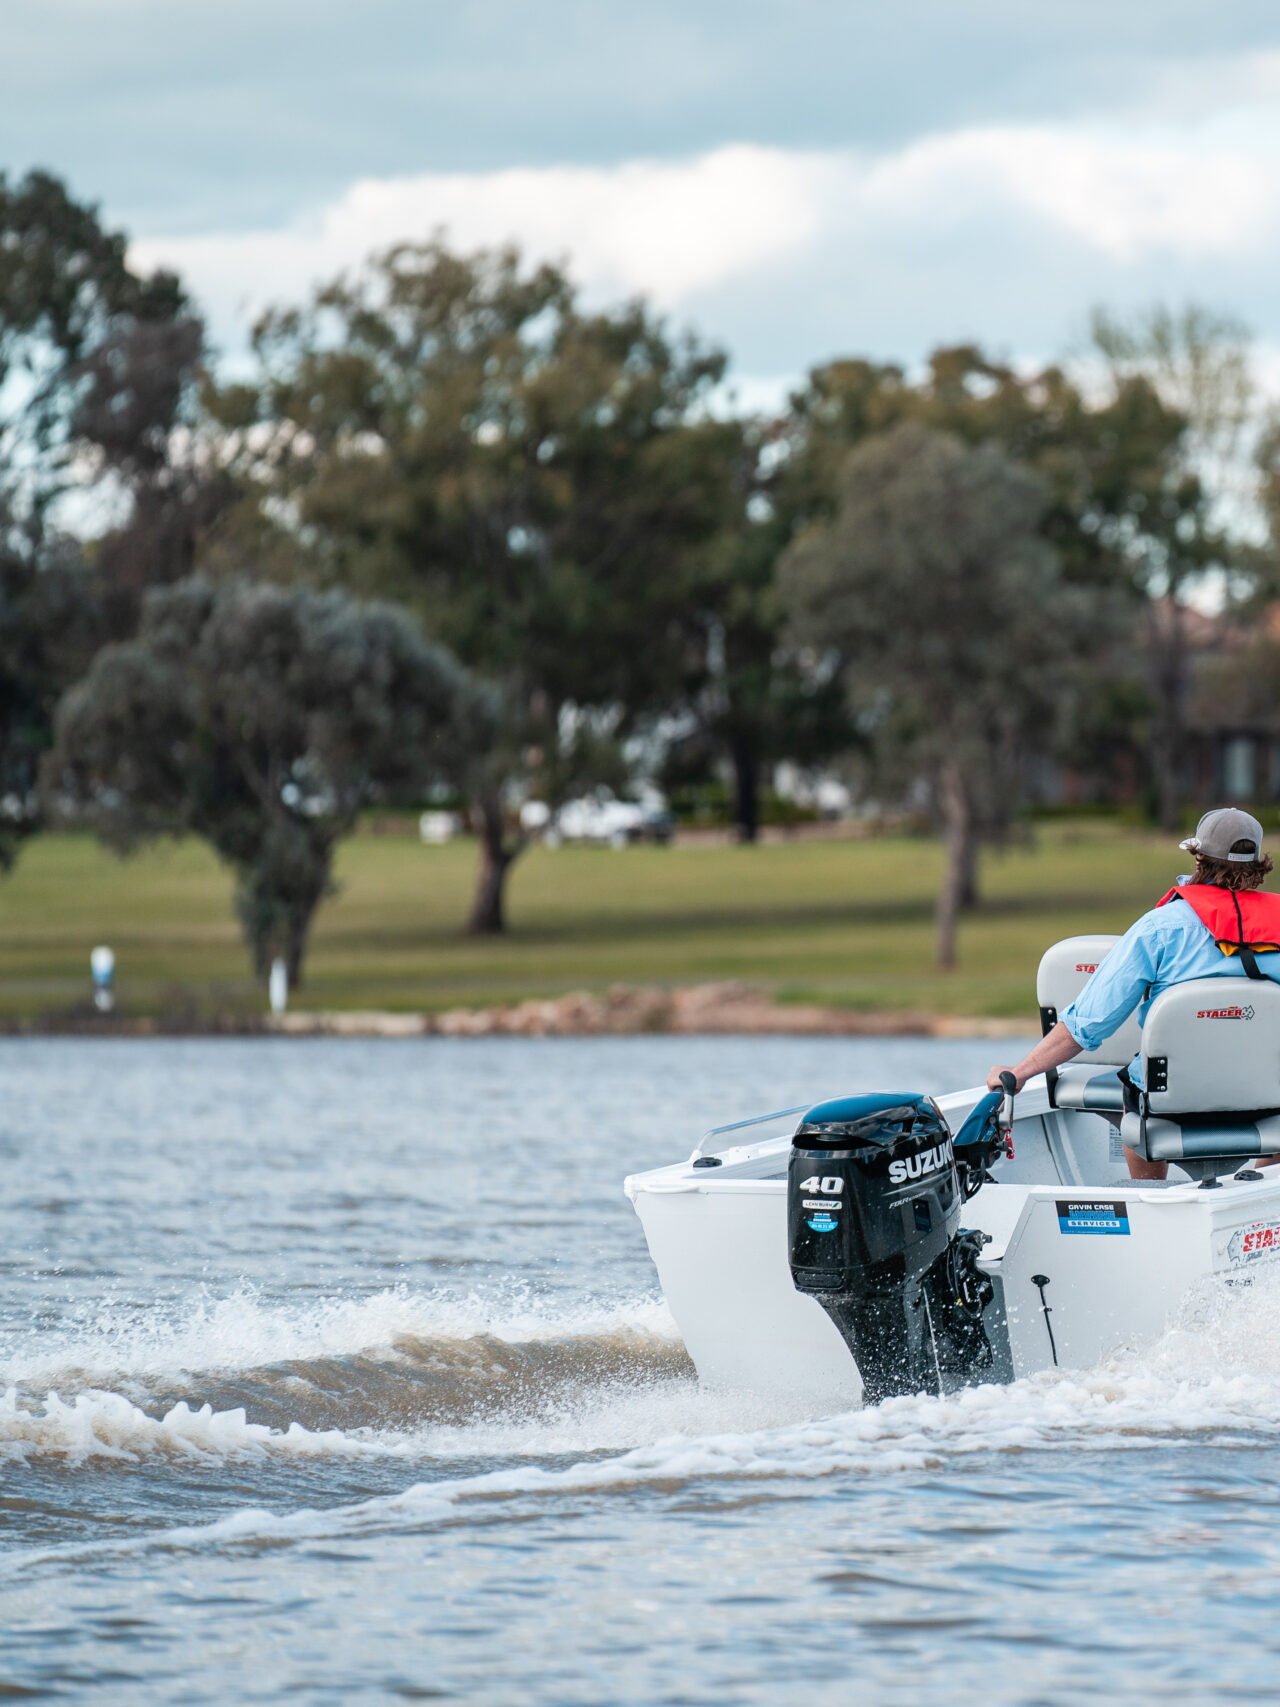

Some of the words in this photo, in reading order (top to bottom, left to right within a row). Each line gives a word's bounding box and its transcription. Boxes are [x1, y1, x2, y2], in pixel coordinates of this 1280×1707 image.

[1197, 1009, 1242, 1019] STACER
[888, 1140, 952, 1184] SUZUK
[800, 1176, 844, 1194] 40
